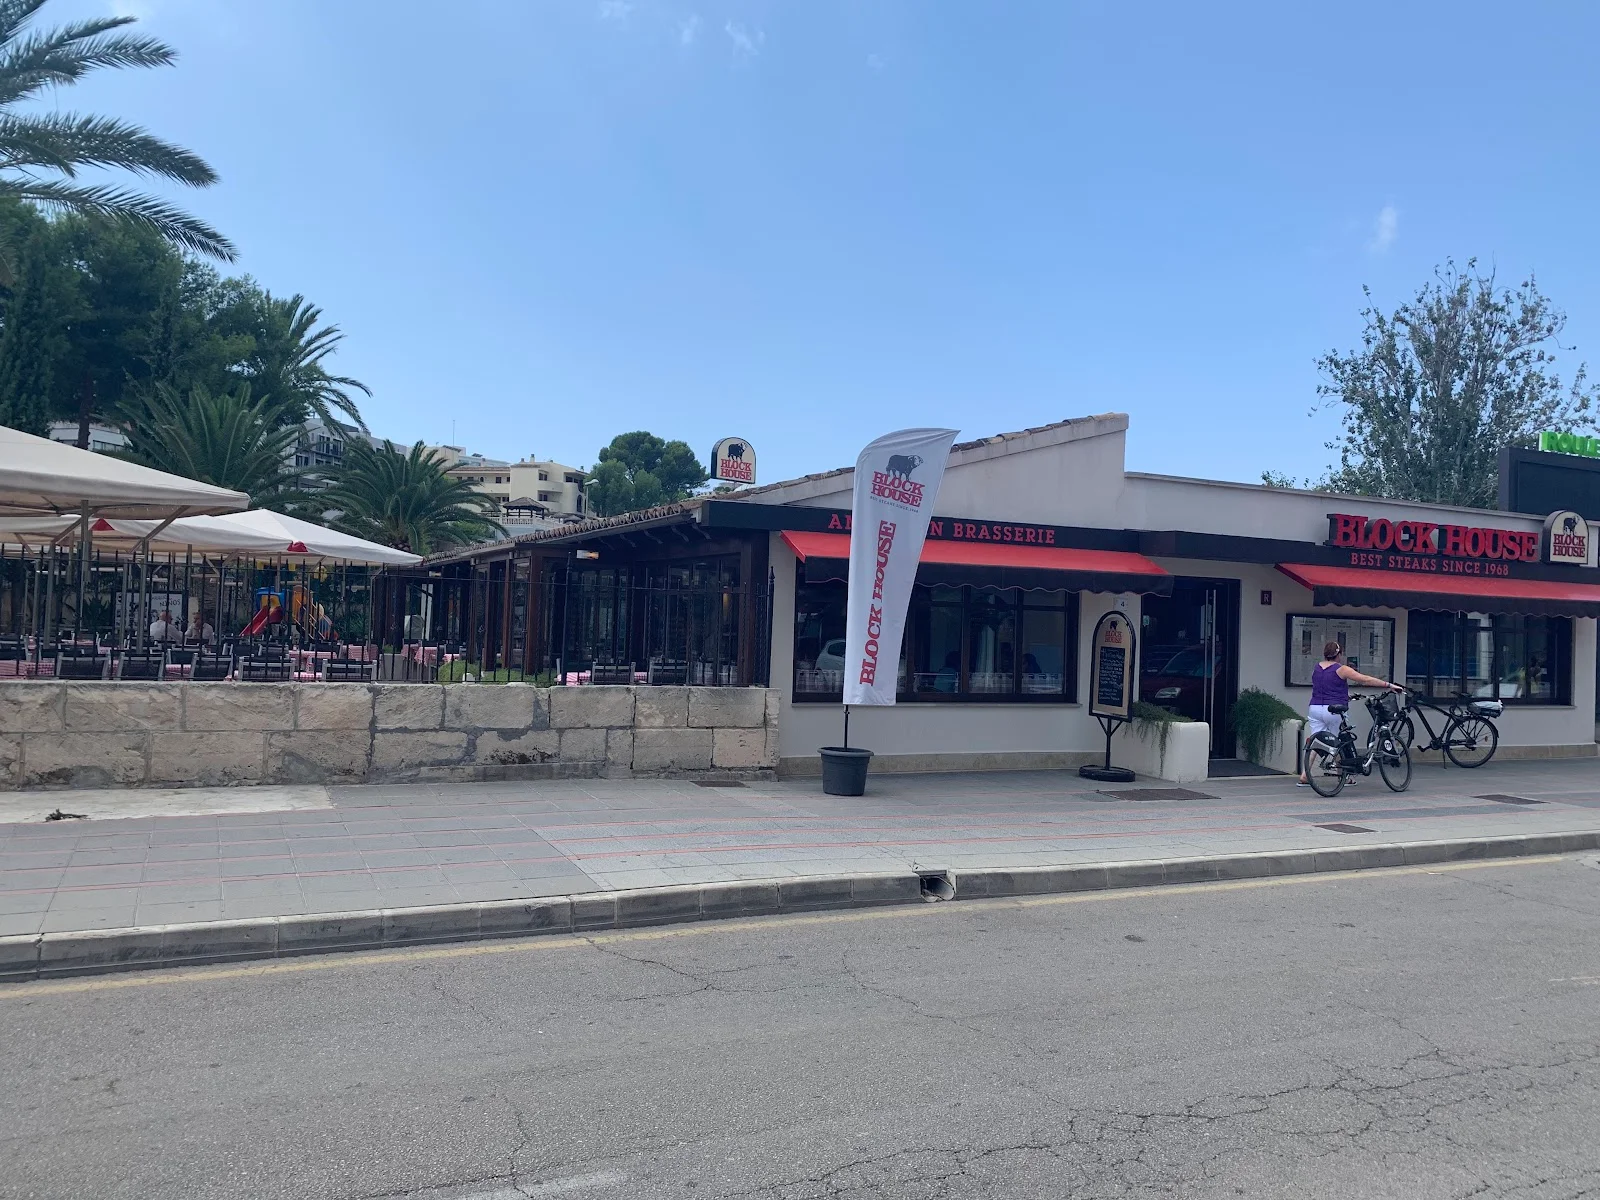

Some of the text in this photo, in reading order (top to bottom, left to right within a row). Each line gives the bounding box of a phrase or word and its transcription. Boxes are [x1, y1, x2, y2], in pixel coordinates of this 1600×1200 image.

[720, 459, 752, 472] BLOCK
[720, 468, 752, 481] HOUSE
[872, 471, 925, 496] BLOCK
[871, 483, 922, 507] HOUSE
[953, 522, 1055, 544] BRASSERIE
[1327, 513, 1539, 562] BLOCK HOUSE
[1553, 533, 1585, 547] BLOCK
[1552, 545, 1585, 558] HOUSE
[1351, 552, 1509, 576] BEST STEAKS SINCE 1968
[859, 519, 897, 687] BLOCK HOUSE
[1105, 630, 1123, 638] BLOCK
